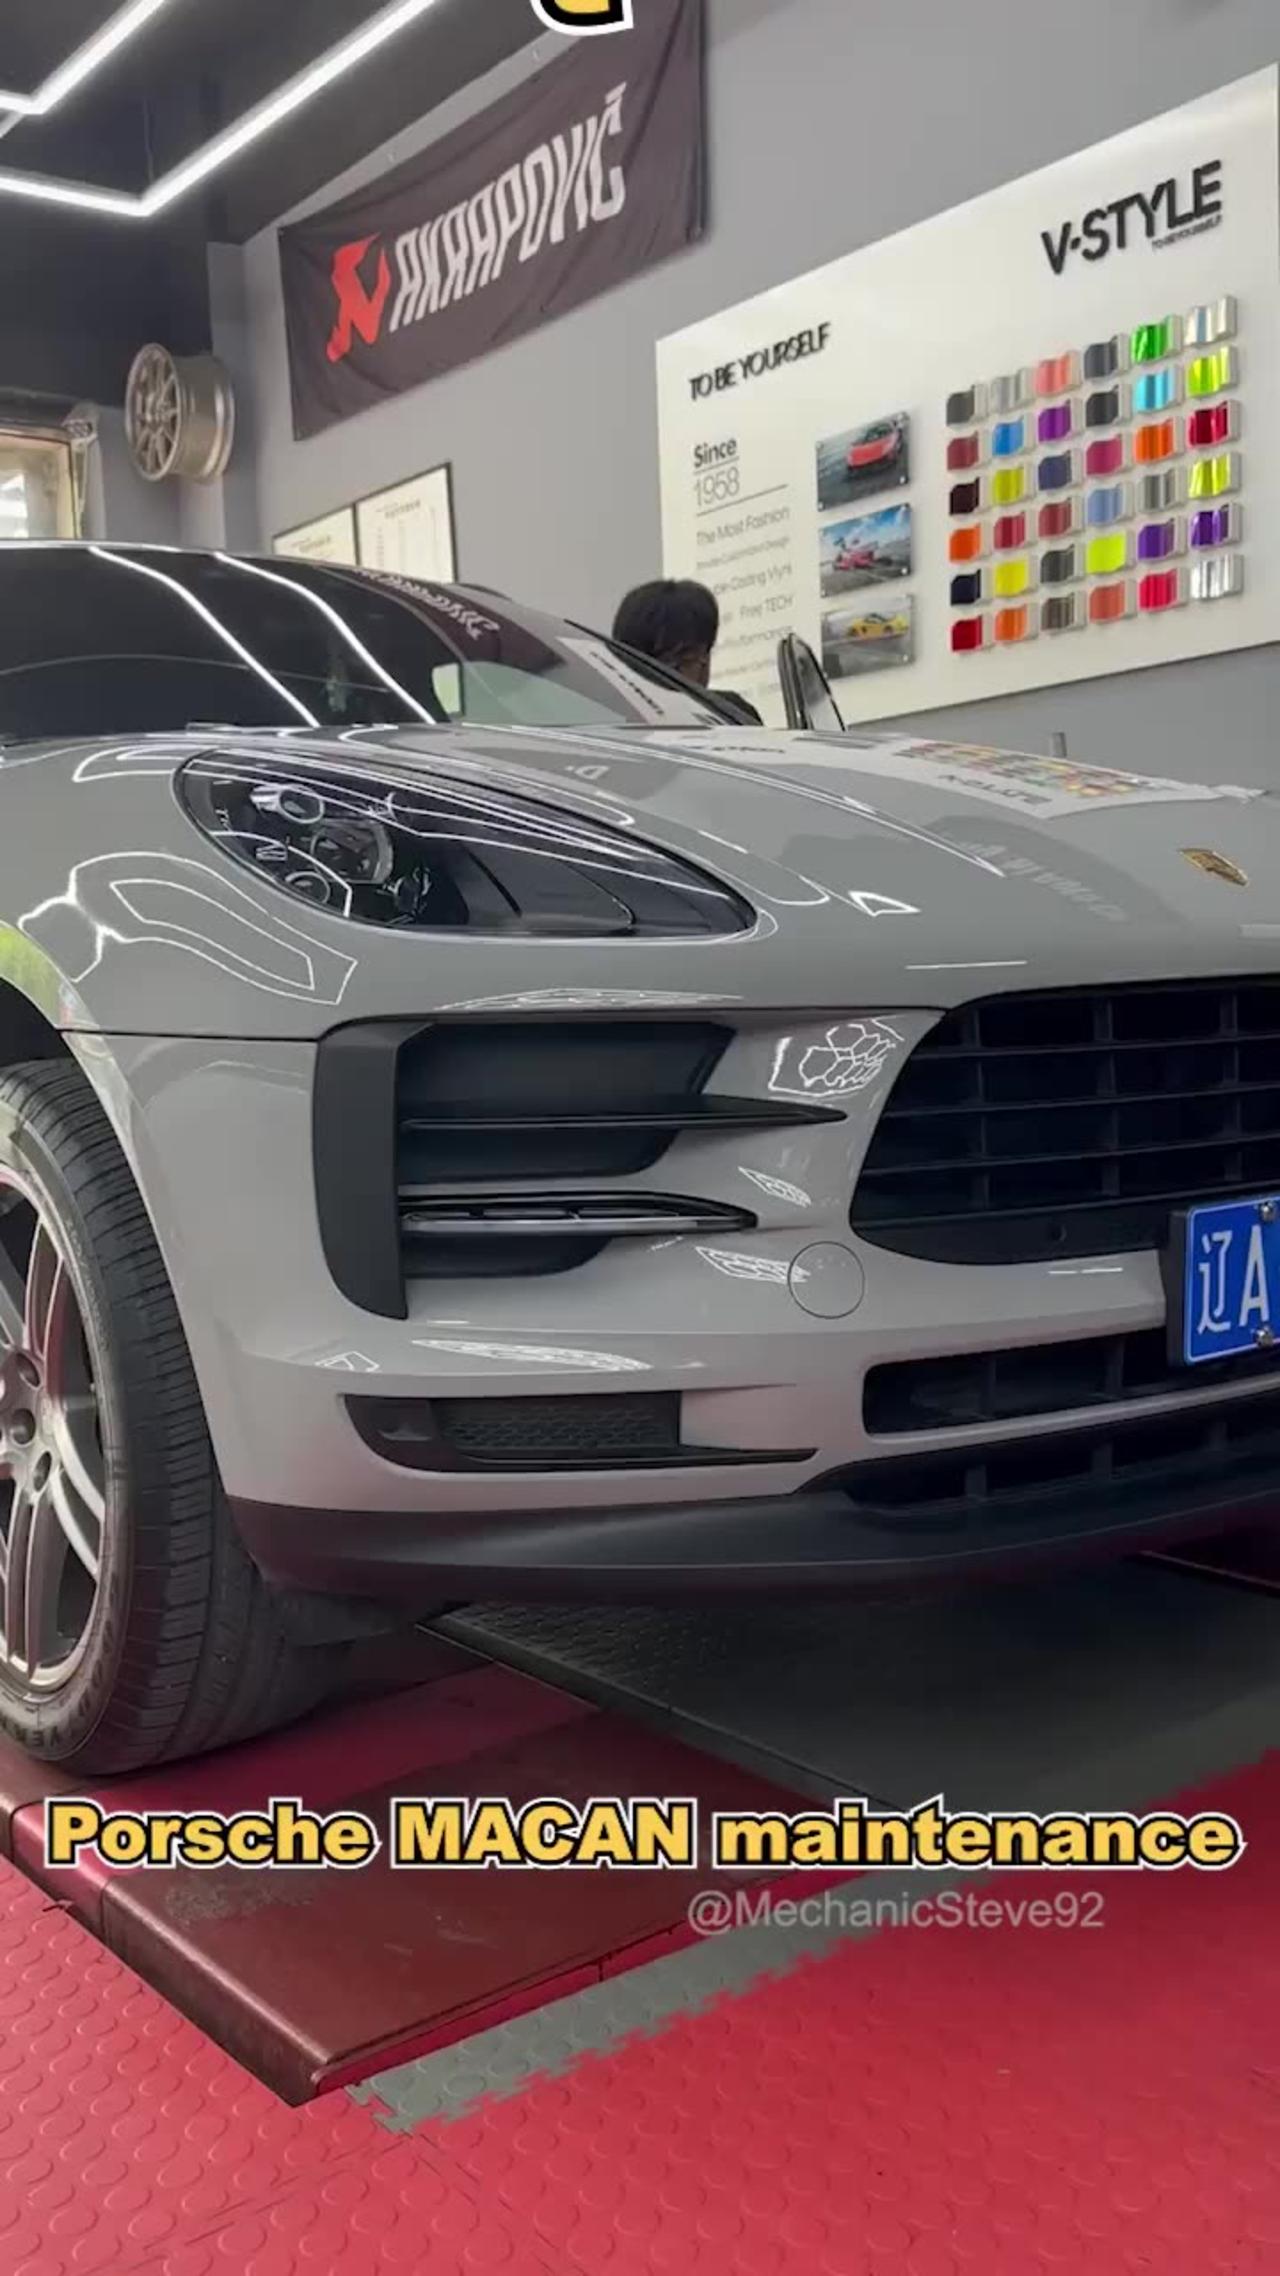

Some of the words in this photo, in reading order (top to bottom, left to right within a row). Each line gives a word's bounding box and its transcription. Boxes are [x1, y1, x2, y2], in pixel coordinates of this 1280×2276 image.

[689, 373, 713, 401] TO
[714, 361, 738, 391] BE
[738, 321, 831, 380] YOURSELF
[693, 437, 737, 469] Since
[693, 465, 740, 507] 1958
[717, 519, 744, 540] Most
[745, 506, 790, 531] Fashion
